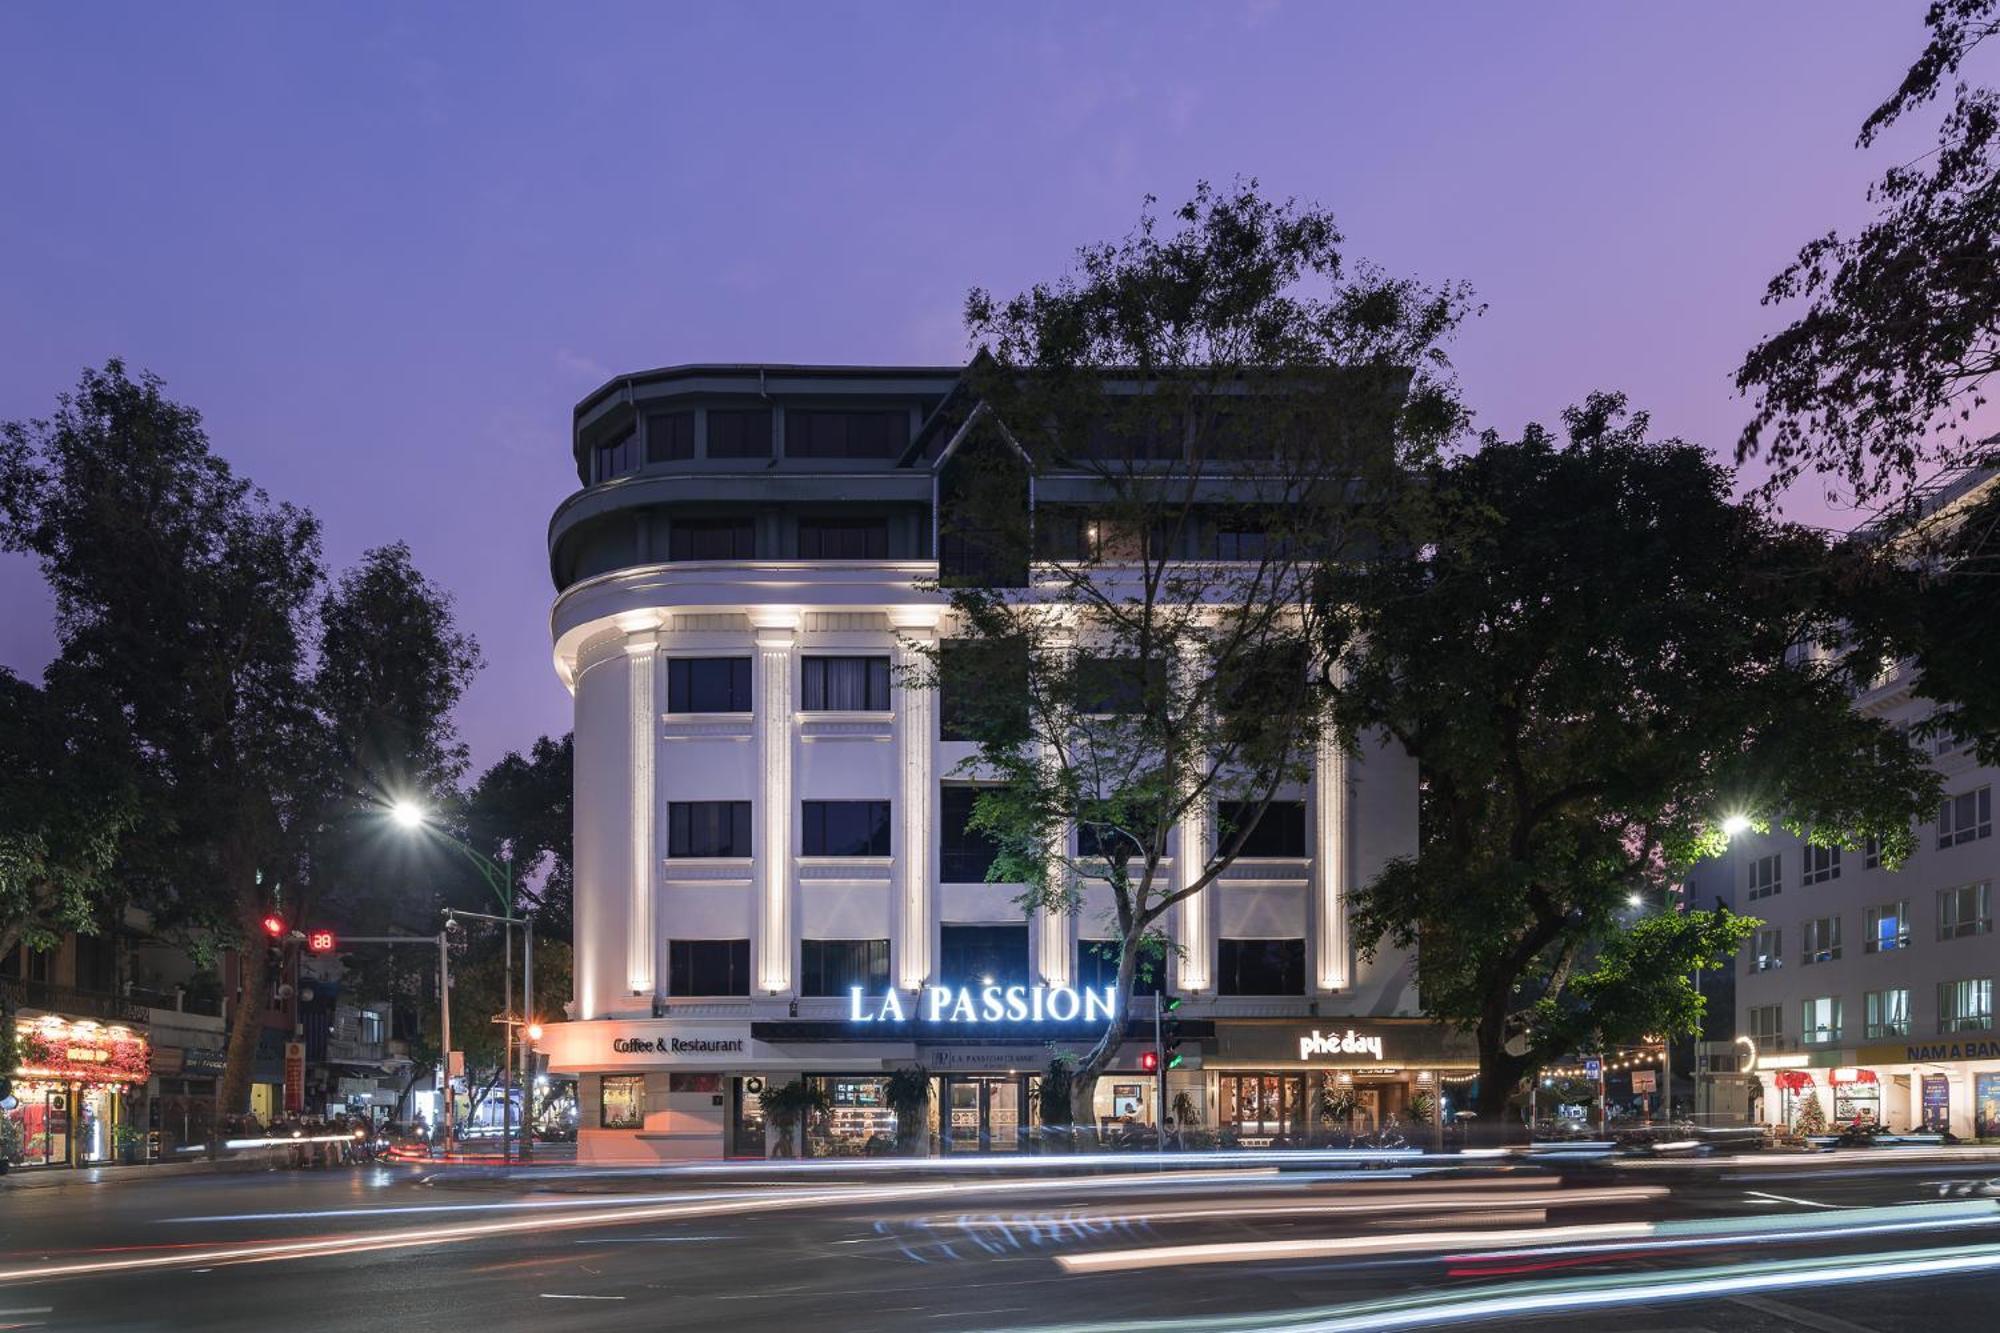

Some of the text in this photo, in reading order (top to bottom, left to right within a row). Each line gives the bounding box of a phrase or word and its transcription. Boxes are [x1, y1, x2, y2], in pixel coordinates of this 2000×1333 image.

[850, 986, 1116, 1022] LA PASSION
[613, 1036, 744, 1053] Coffee & Restaurant
[1907, 1044, 1947, 1061] NAM
[1950, 1043, 1961, 1059] A
